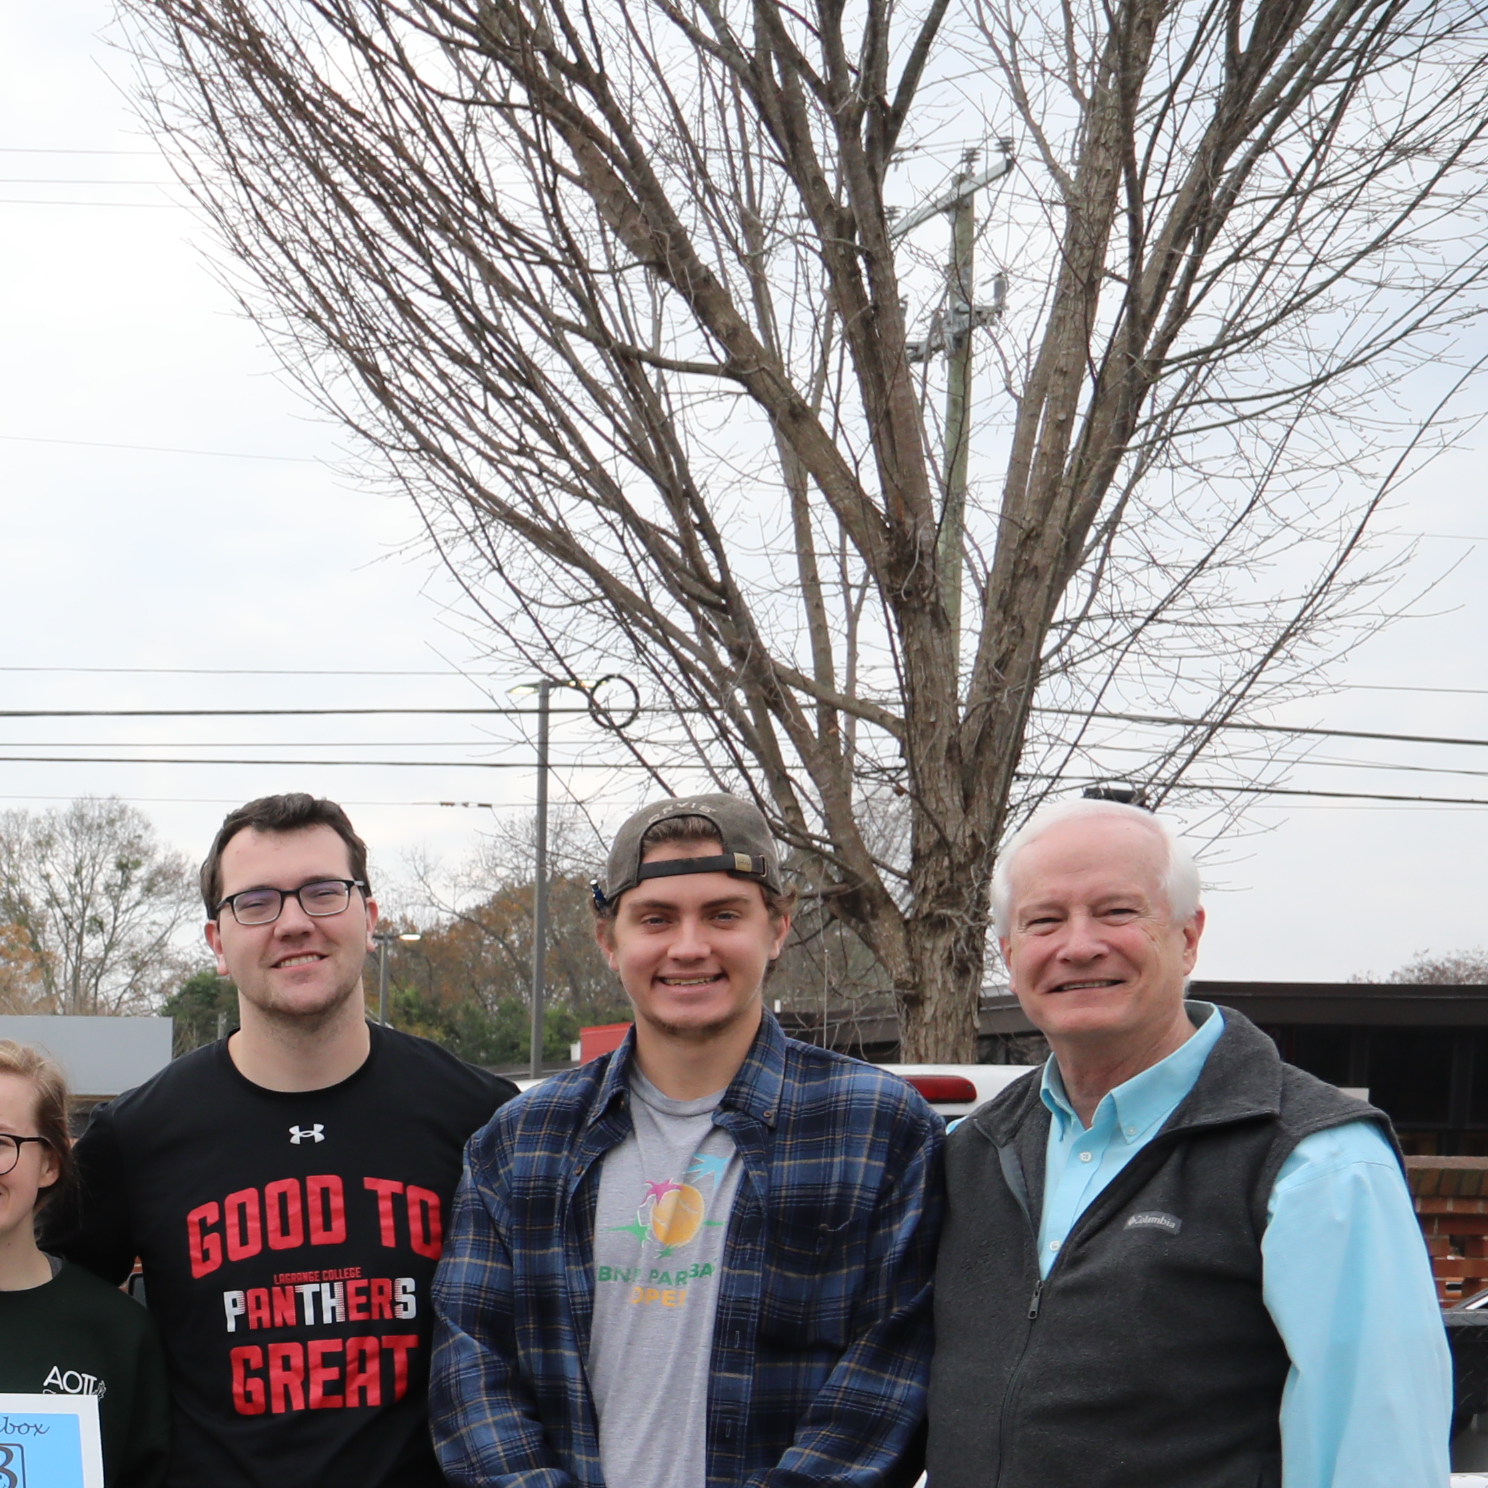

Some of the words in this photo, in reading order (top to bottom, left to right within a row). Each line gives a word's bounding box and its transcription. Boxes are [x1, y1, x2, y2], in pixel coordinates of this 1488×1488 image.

[648, 802, 714, 824] ORVIS
[186, 1174, 347, 1280] GOOD
[362, 1176, 443, 1262] TO
[273, 1270, 321, 1285] LAGRANGE
[322, 1266, 362, 1280] COLLEGE
[223, 1276, 417, 1333] PANTHERS
[229, 1333, 419, 1416] GREAT
